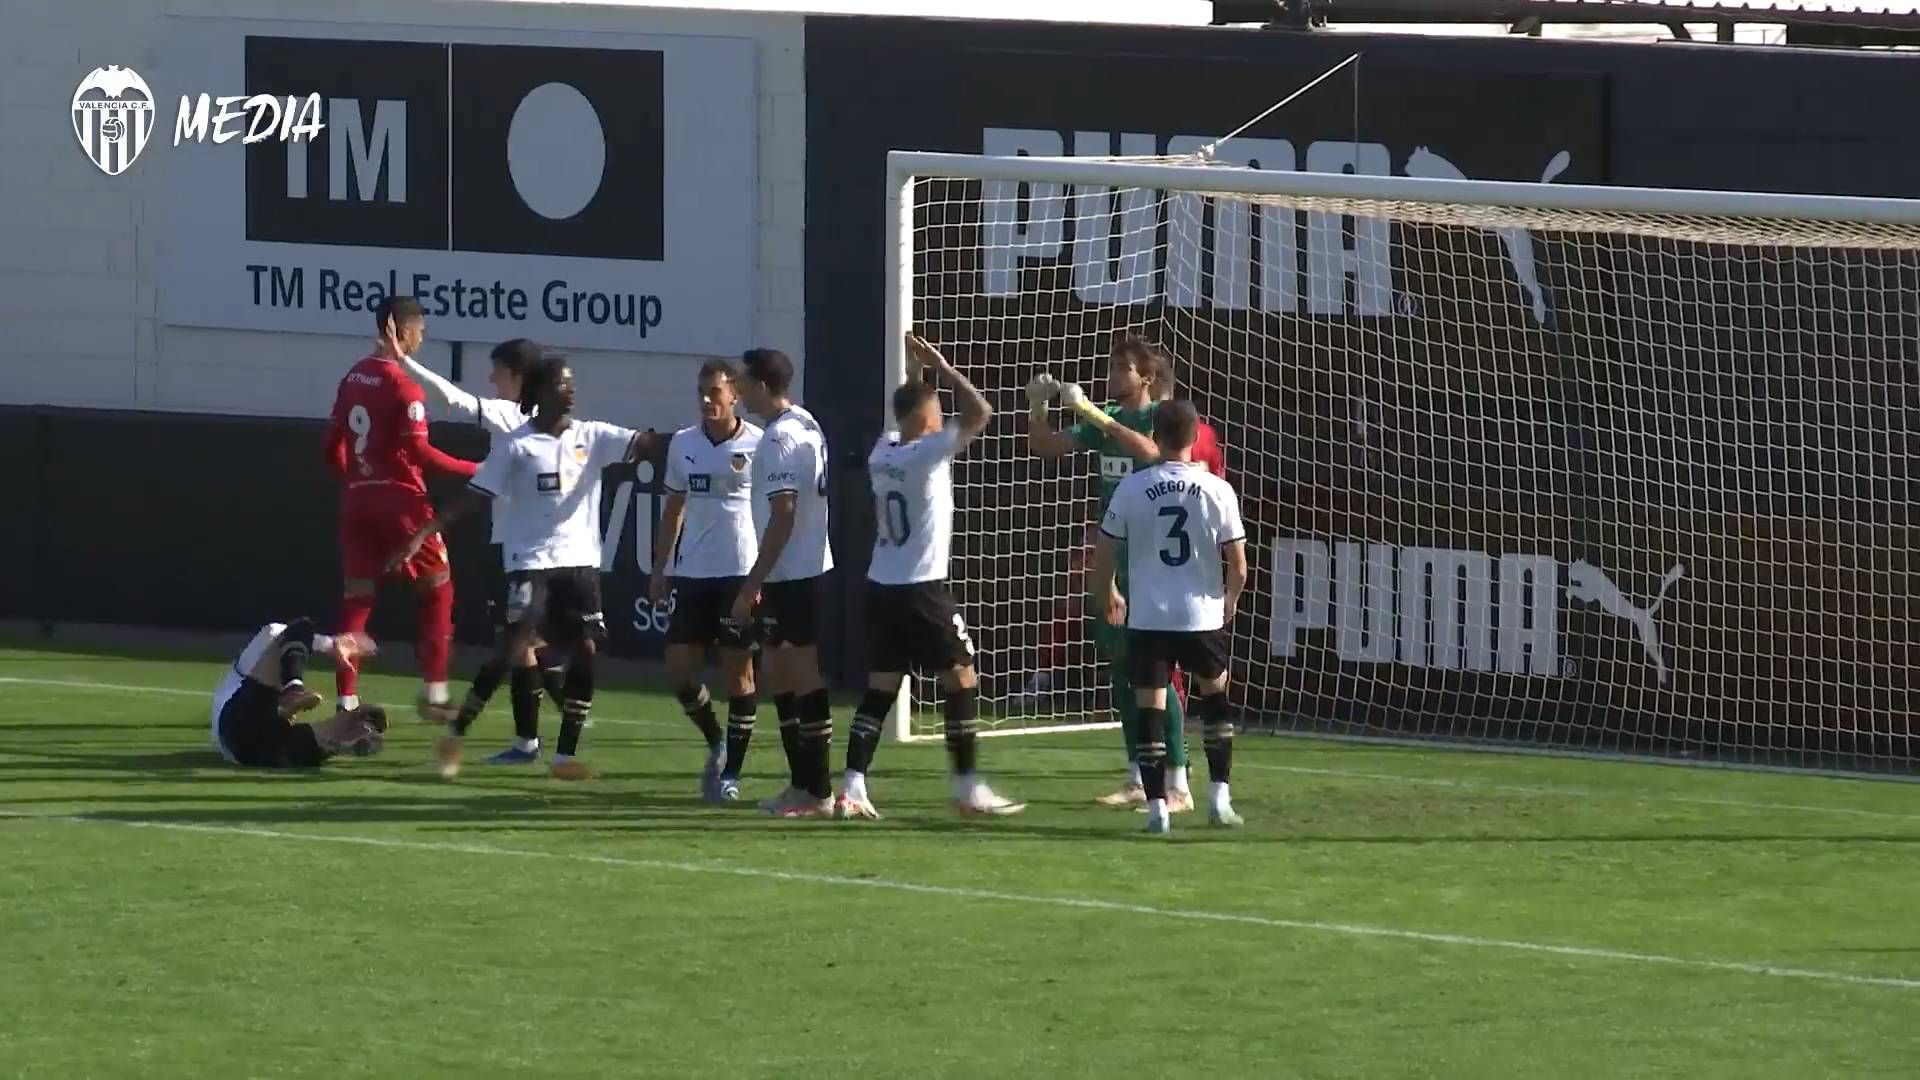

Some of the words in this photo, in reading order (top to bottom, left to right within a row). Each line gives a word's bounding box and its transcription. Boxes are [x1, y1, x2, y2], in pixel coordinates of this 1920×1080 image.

[264, 96, 407, 203] TM
[982, 127, 1392, 317] PUMA
[246, 265, 303, 308] TM
[319, 269, 396, 313] Real
[412, 273, 529, 320] Estate
[542, 279, 663, 338] Group
[348, 404, 371, 454] 9
[1145, 480, 1185, 501] DIEGO
[1158, 505, 1190, 567] 3
[1271, 536, 1559, 676] PUMA
